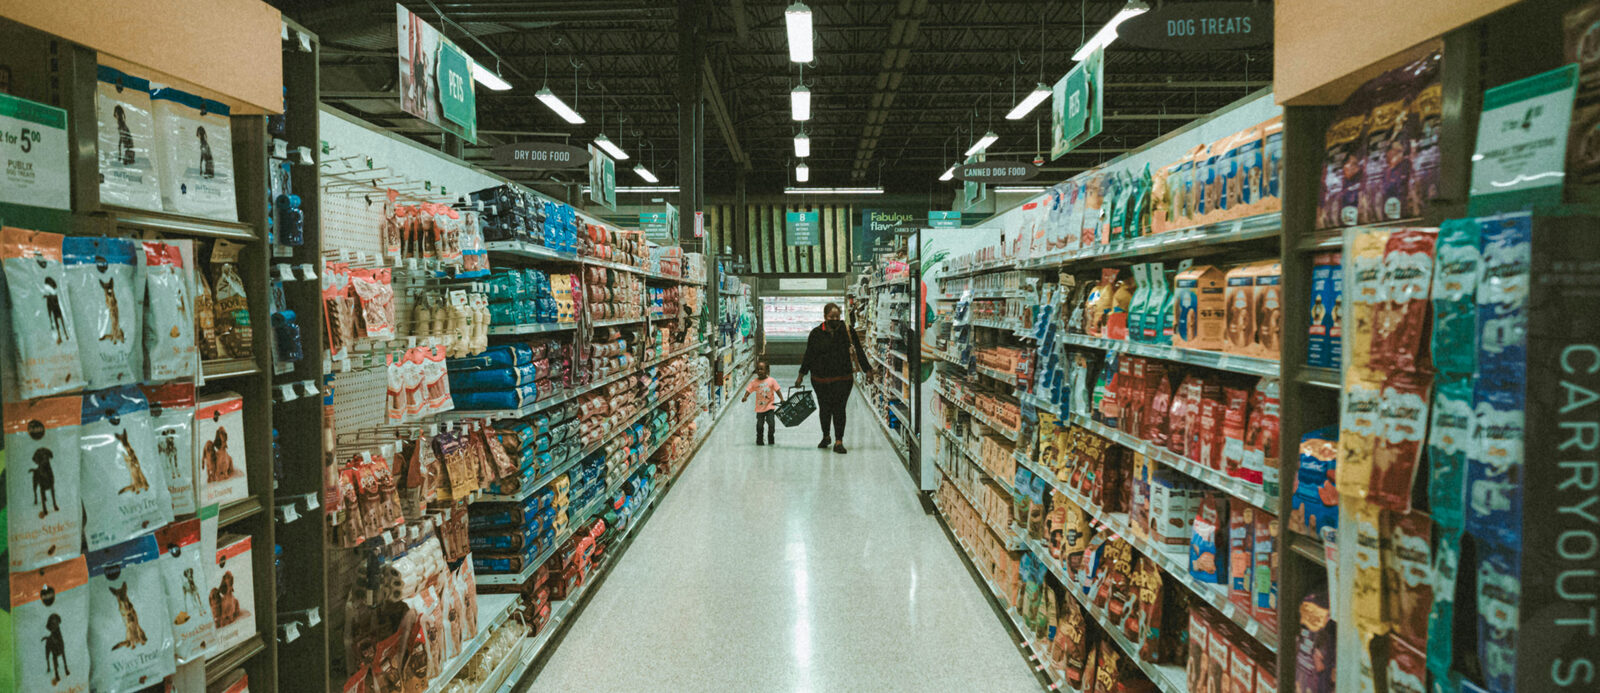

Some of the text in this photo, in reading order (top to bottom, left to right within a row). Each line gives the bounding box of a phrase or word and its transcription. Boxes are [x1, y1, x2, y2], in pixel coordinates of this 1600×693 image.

[1167, 16, 1251, 36] DOG TREATS
[449, 69, 464, 102] PETS
[514, 149, 570, 162] DRY DOG FOOD
[8, 159, 33, 170] PUBLIX
[964, 167, 1026, 177] CANNED DOG FOOD
[799, 213, 806, 221] 8
[871, 212, 913, 222] Fabulous
[942, 211, 948, 220] 7
[1554, 344, 1600, 635] CARRYOUT
